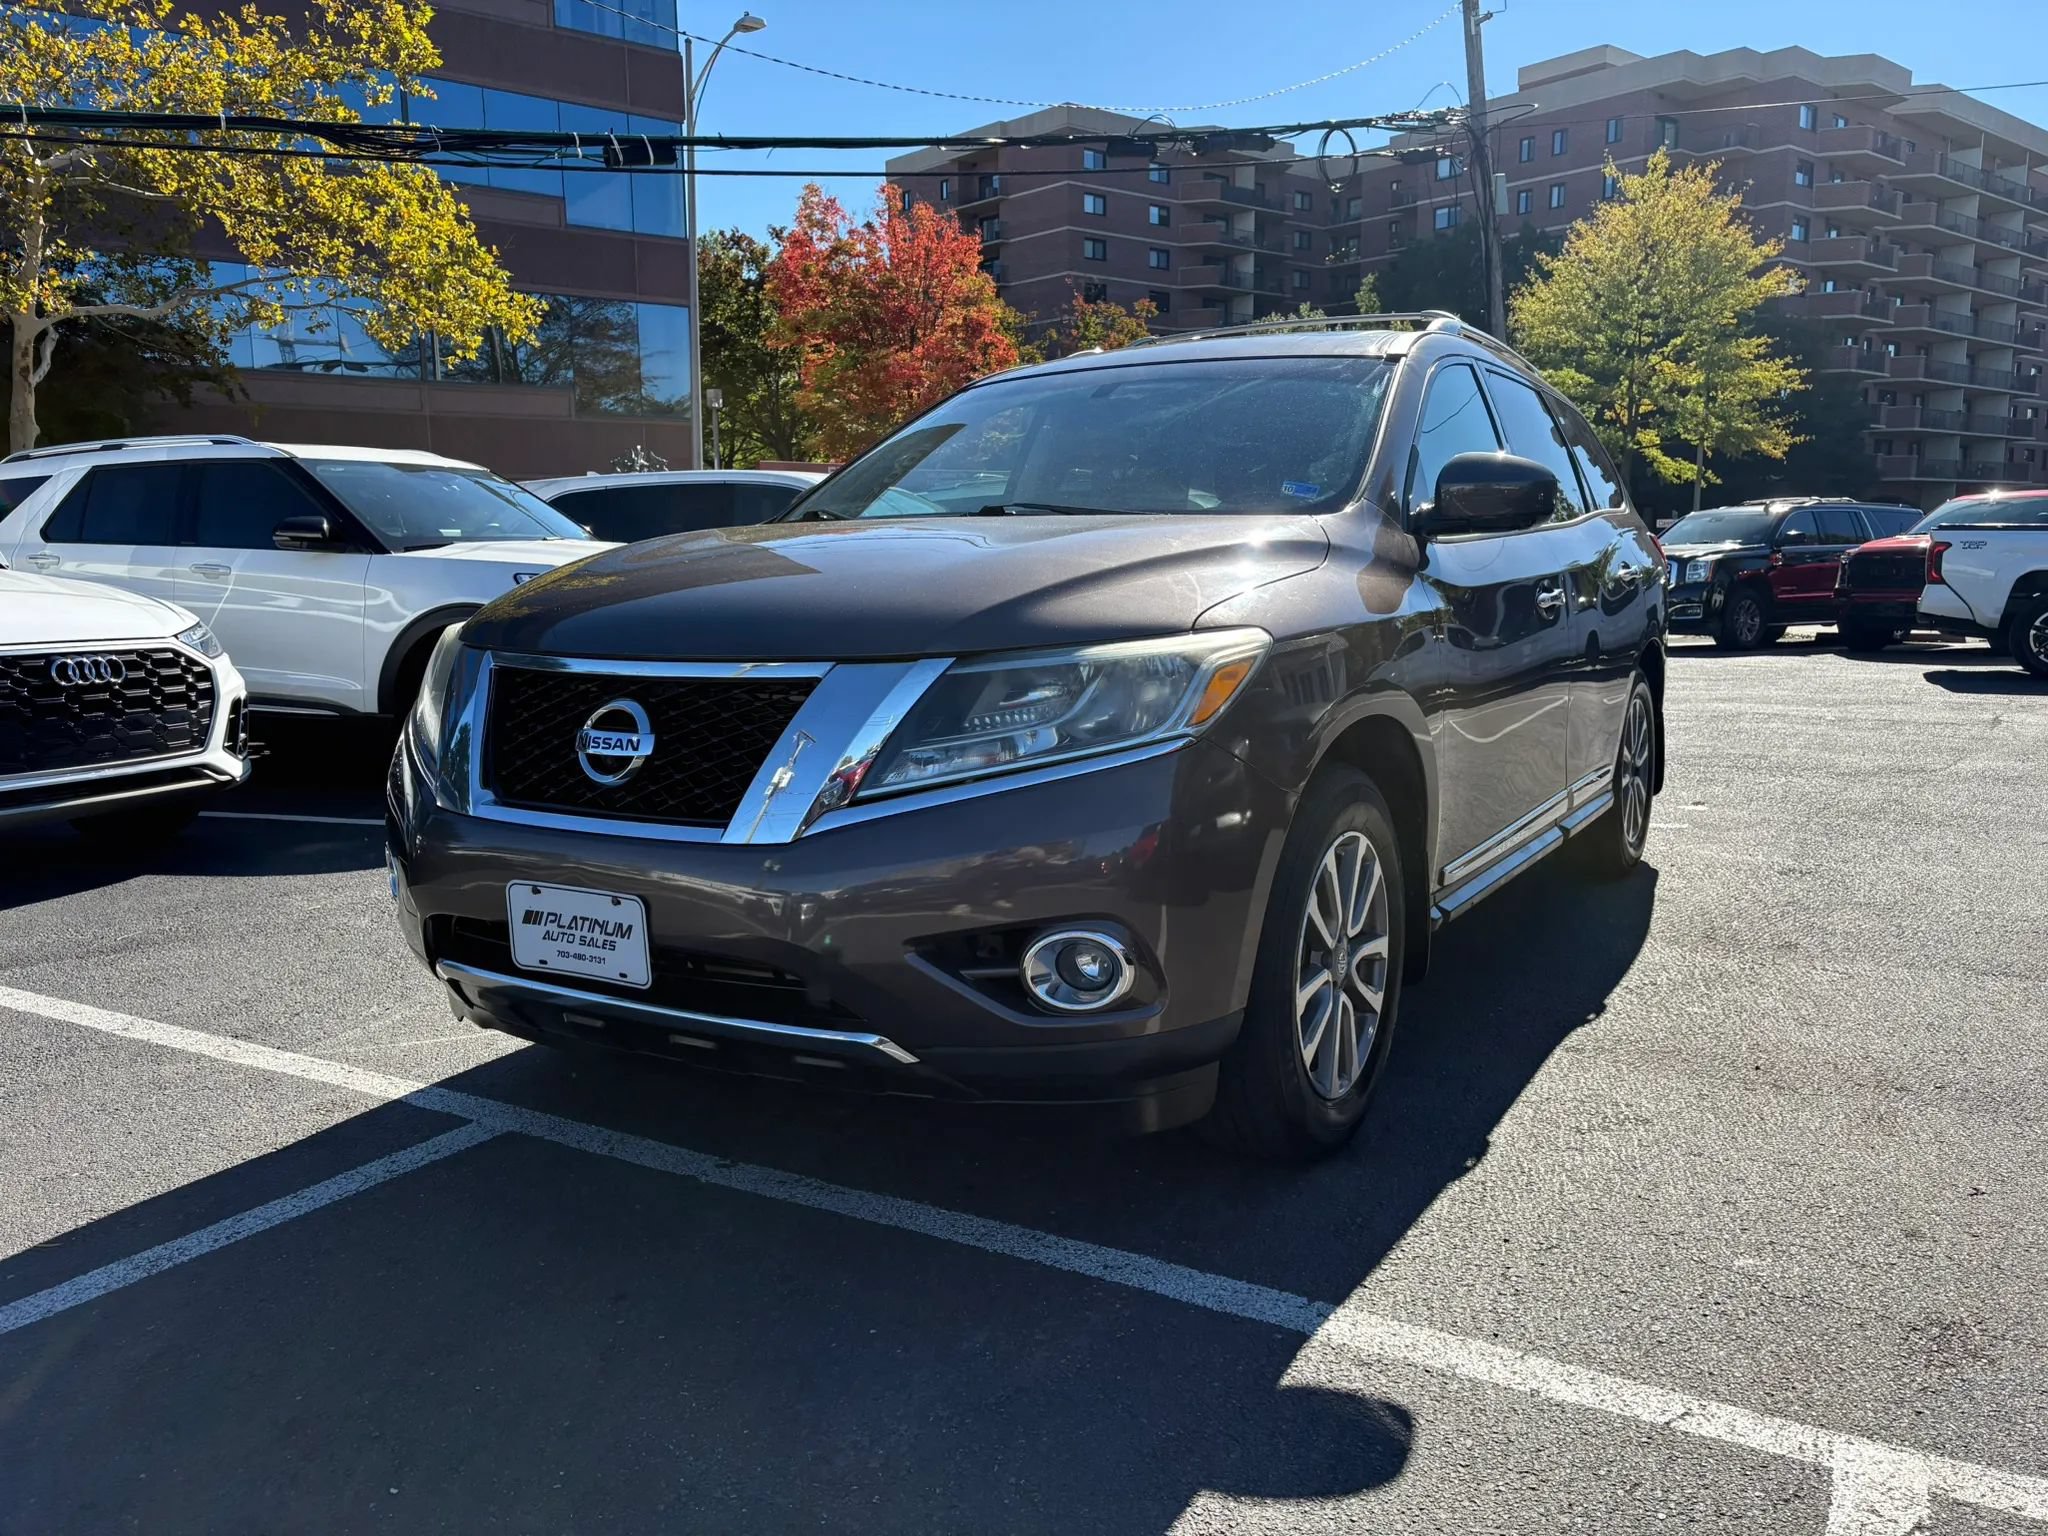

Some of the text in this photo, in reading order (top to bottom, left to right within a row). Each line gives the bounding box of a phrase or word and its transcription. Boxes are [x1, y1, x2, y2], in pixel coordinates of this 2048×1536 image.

[580, 732, 641, 752] NISSAN
[544, 912, 633, 940] PLATINUM
[542, 930, 617, 951] AUTO SALES
